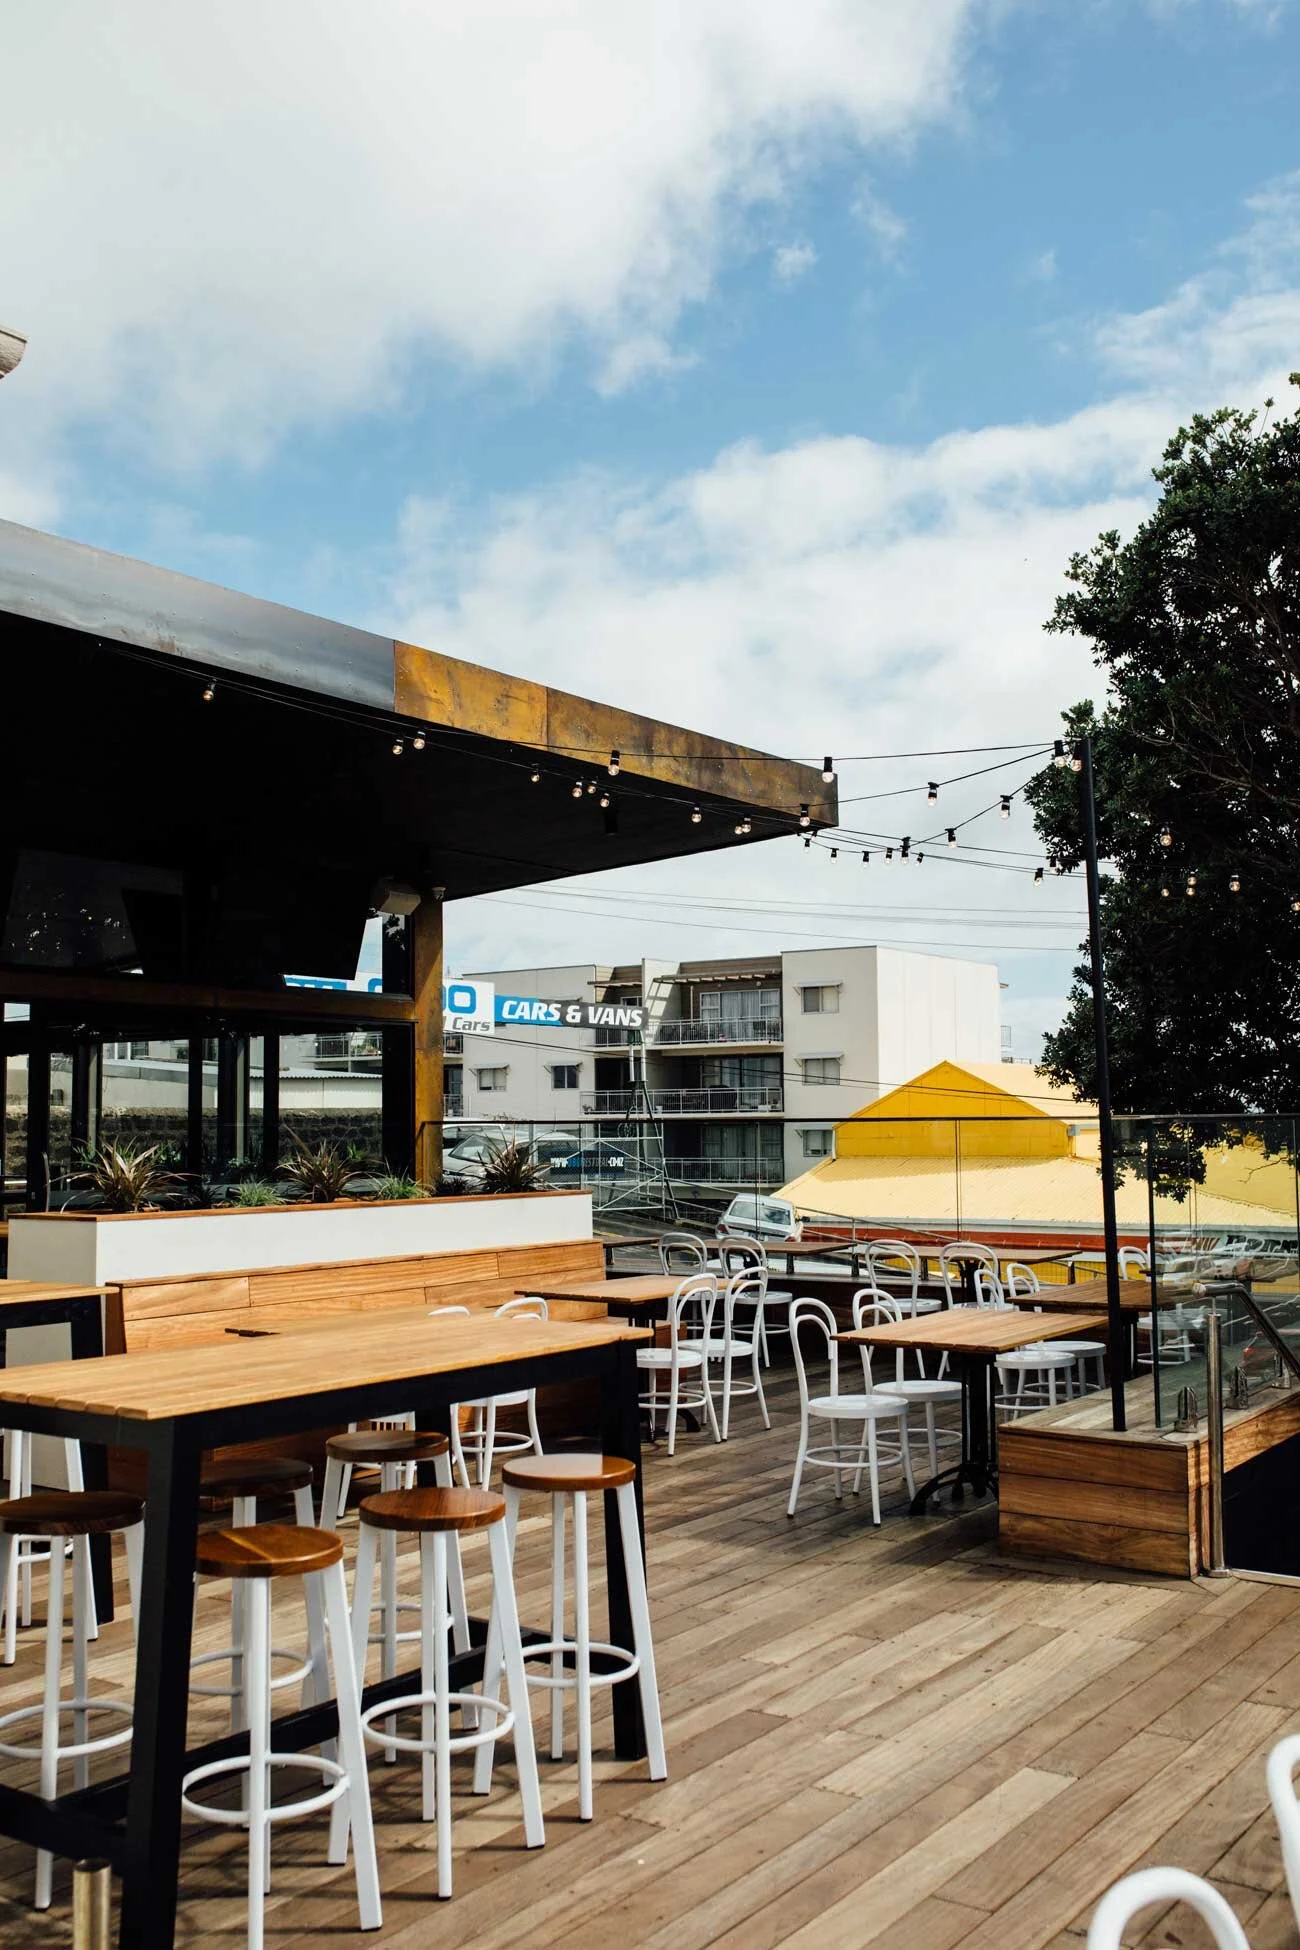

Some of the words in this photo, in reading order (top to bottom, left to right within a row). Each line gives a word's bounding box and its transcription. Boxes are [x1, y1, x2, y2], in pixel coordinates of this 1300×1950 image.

[452, 1016, 490, 1032] Cars
[501, 1000, 562, 1021] CARS
[565, 1004, 582, 1024] &
[587, 1005, 644, 1027] VANS
